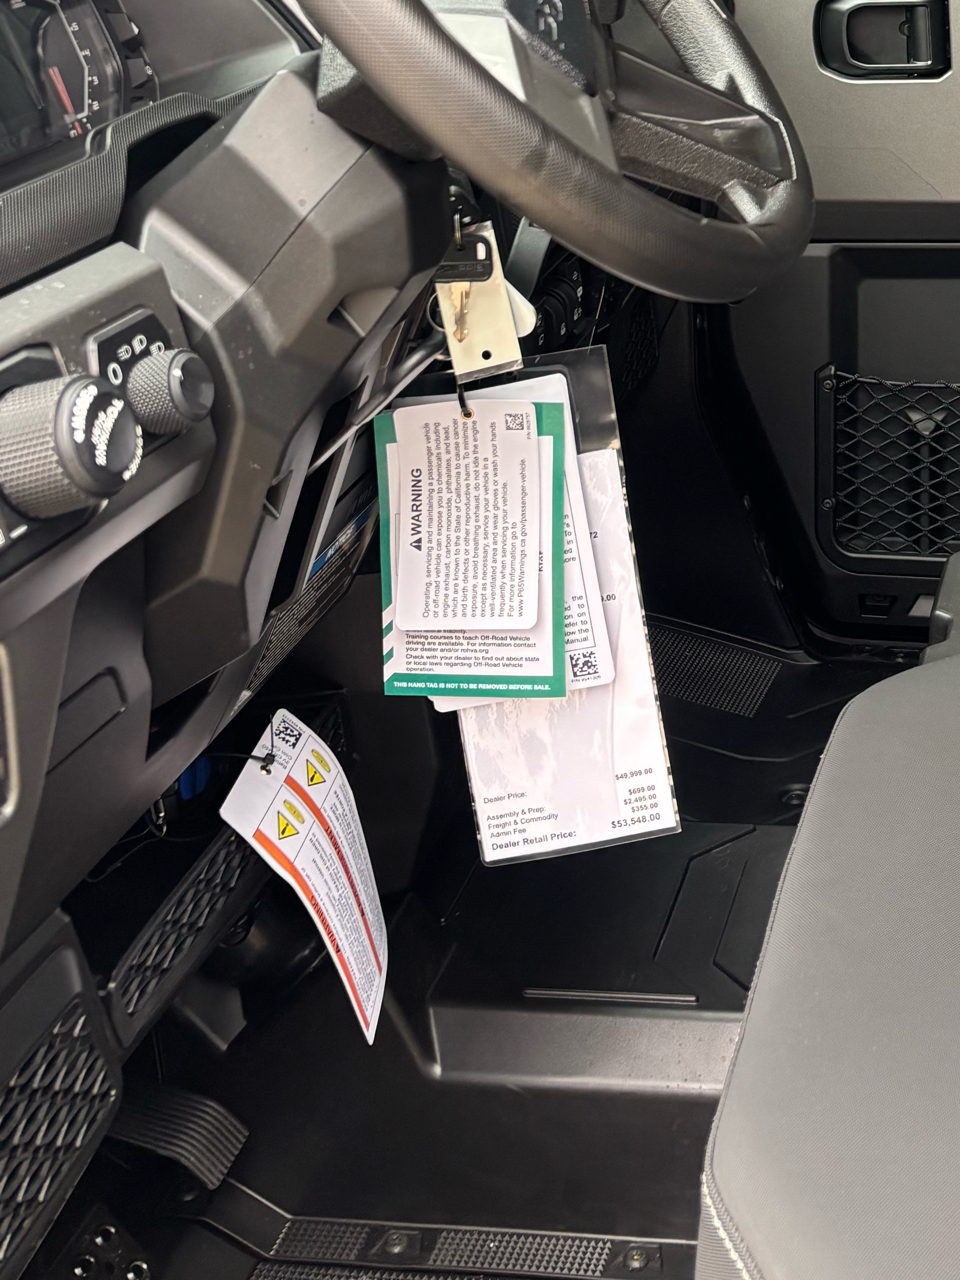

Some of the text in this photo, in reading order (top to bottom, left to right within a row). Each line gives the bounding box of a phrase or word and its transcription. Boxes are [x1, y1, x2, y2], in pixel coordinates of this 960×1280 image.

[433, 422, 441, 450] including
[426, 446, 434, 480] passenger
[445, 457, 453, 493] phthalates,
[411, 469, 422, 536] WARNING
[473, 483, 480, 491] do
[492, 488, 500, 511] gloves
[427, 489, 435, 528] maintaining
[472, 525, 481, 558] breathing
[501, 527, 509, 558] servicing
[511, 531, 518, 540] go
[482, 542, 490, 580] necessary,
[423, 580, 432, 618] Operating,
[481, 583, 487, 591] as
[484, 768, 652, 804] Dealer Price: $49,999.00
[487, 811, 519, 821] Assembly
[628, 785, 655, 795] $699.00
[488, 821, 511, 830] Freight
[520, 813, 558, 824] Commodity
[624, 794, 656, 805] $2,495.00
[490, 830, 511, 838] Admin
[631, 802, 658, 813] $355.00
[492, 813, 660, 850] Dealer Retail Price: $53,548.00
